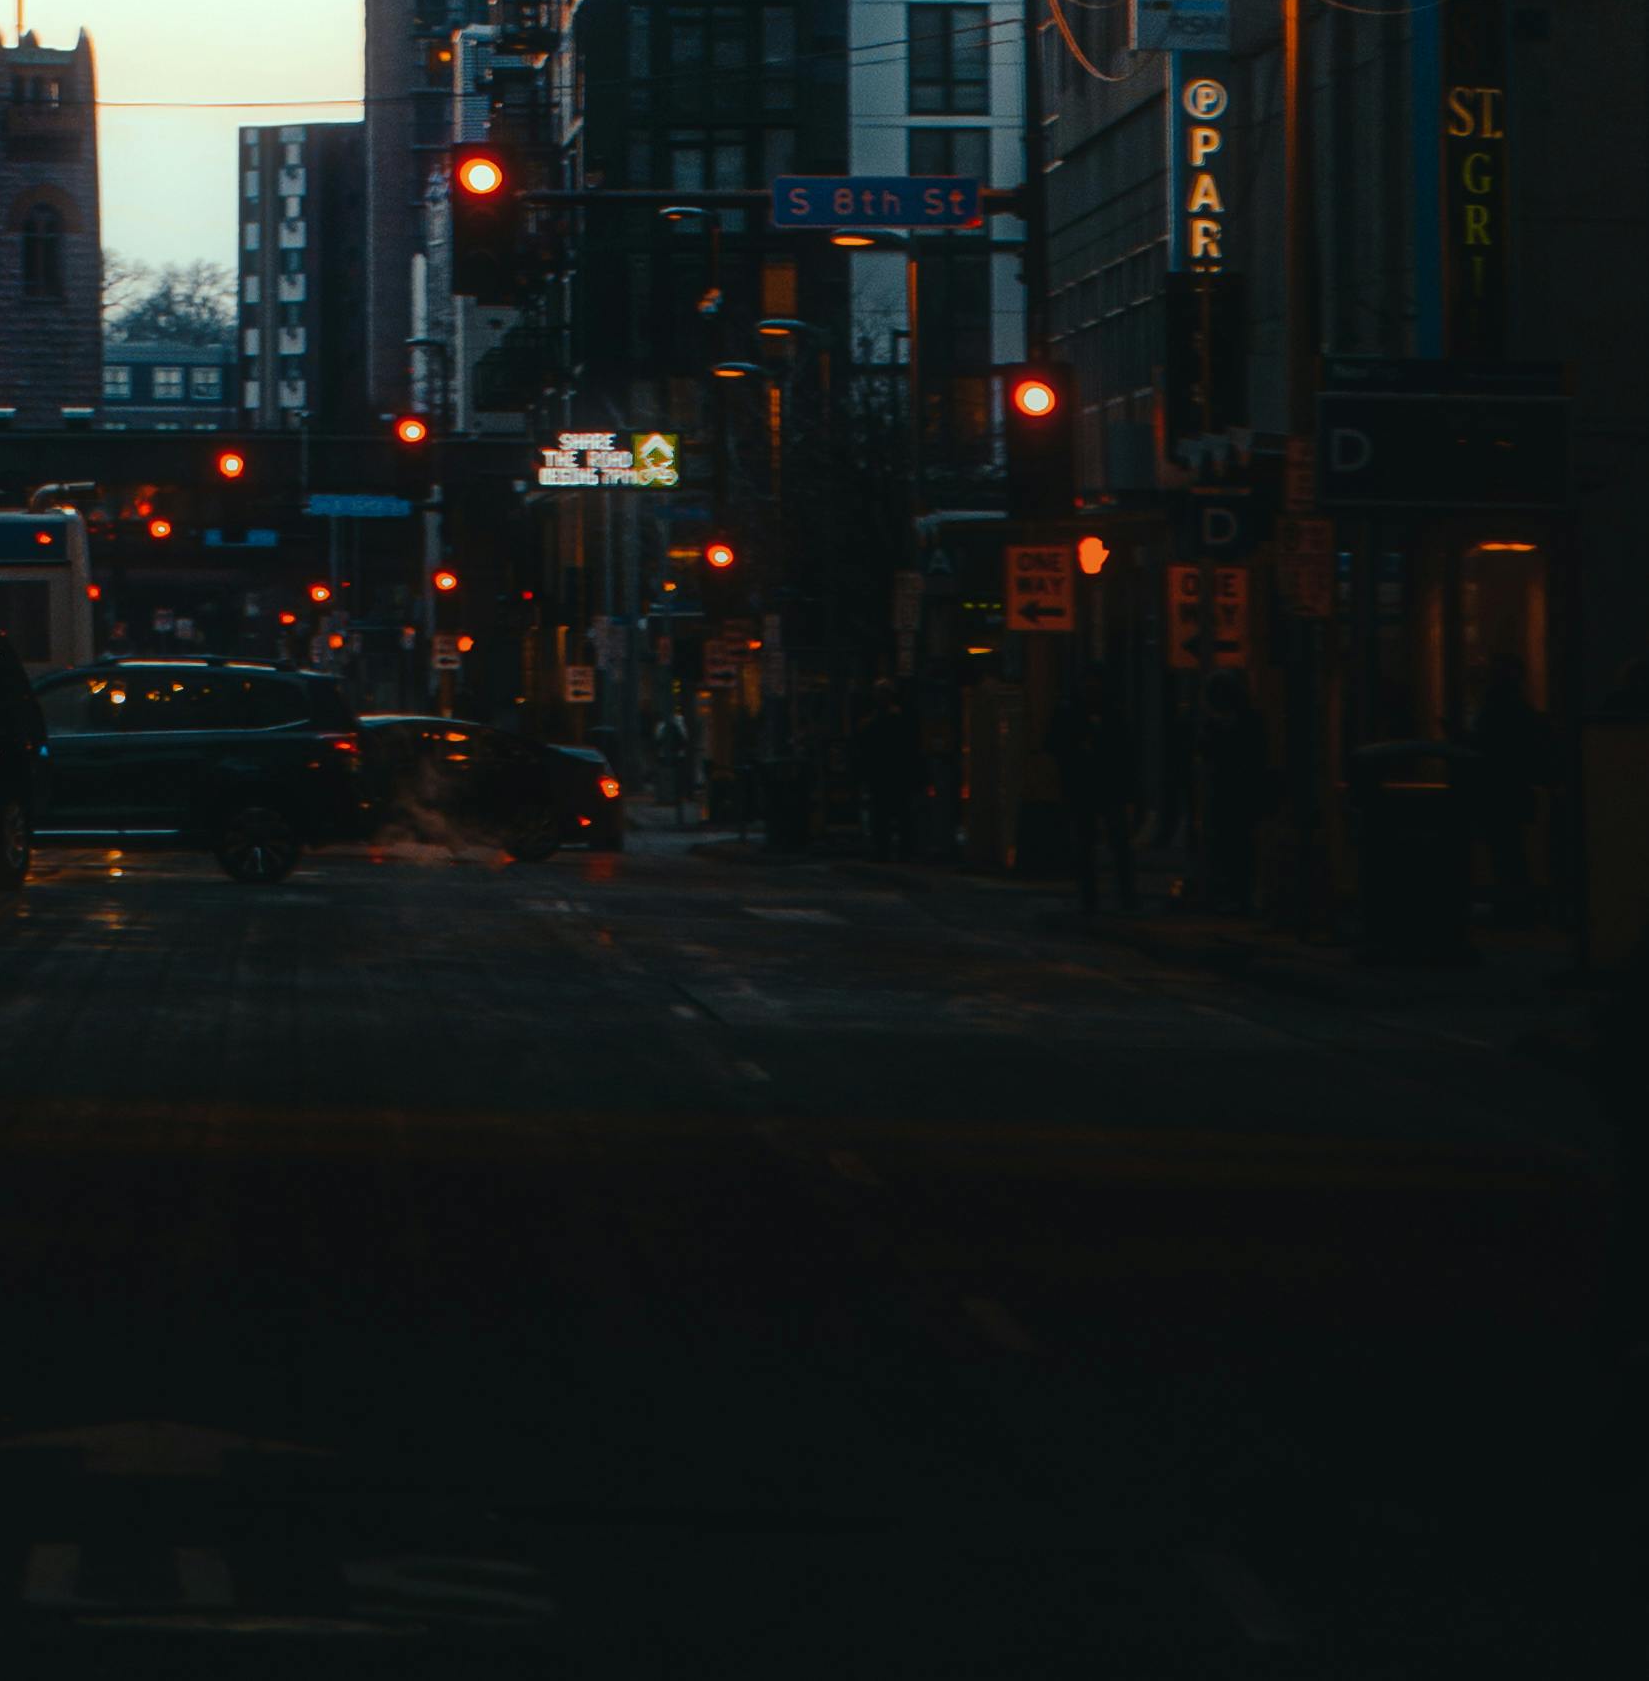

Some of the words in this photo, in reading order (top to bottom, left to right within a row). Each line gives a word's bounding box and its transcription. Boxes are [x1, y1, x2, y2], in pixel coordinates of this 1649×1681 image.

[788, 187, 811, 216] S
[833, 187, 902, 216] 8th
[924, 187, 966, 217] St
[541, 449, 580, 468] THE
[1329, 428, 1374, 473] D
[1202, 507, 1237, 544] D
[1016, 552, 1063, 573] ONE
[1016, 576, 1066, 596] WAY
[1182, 573, 1238, 597] OE
